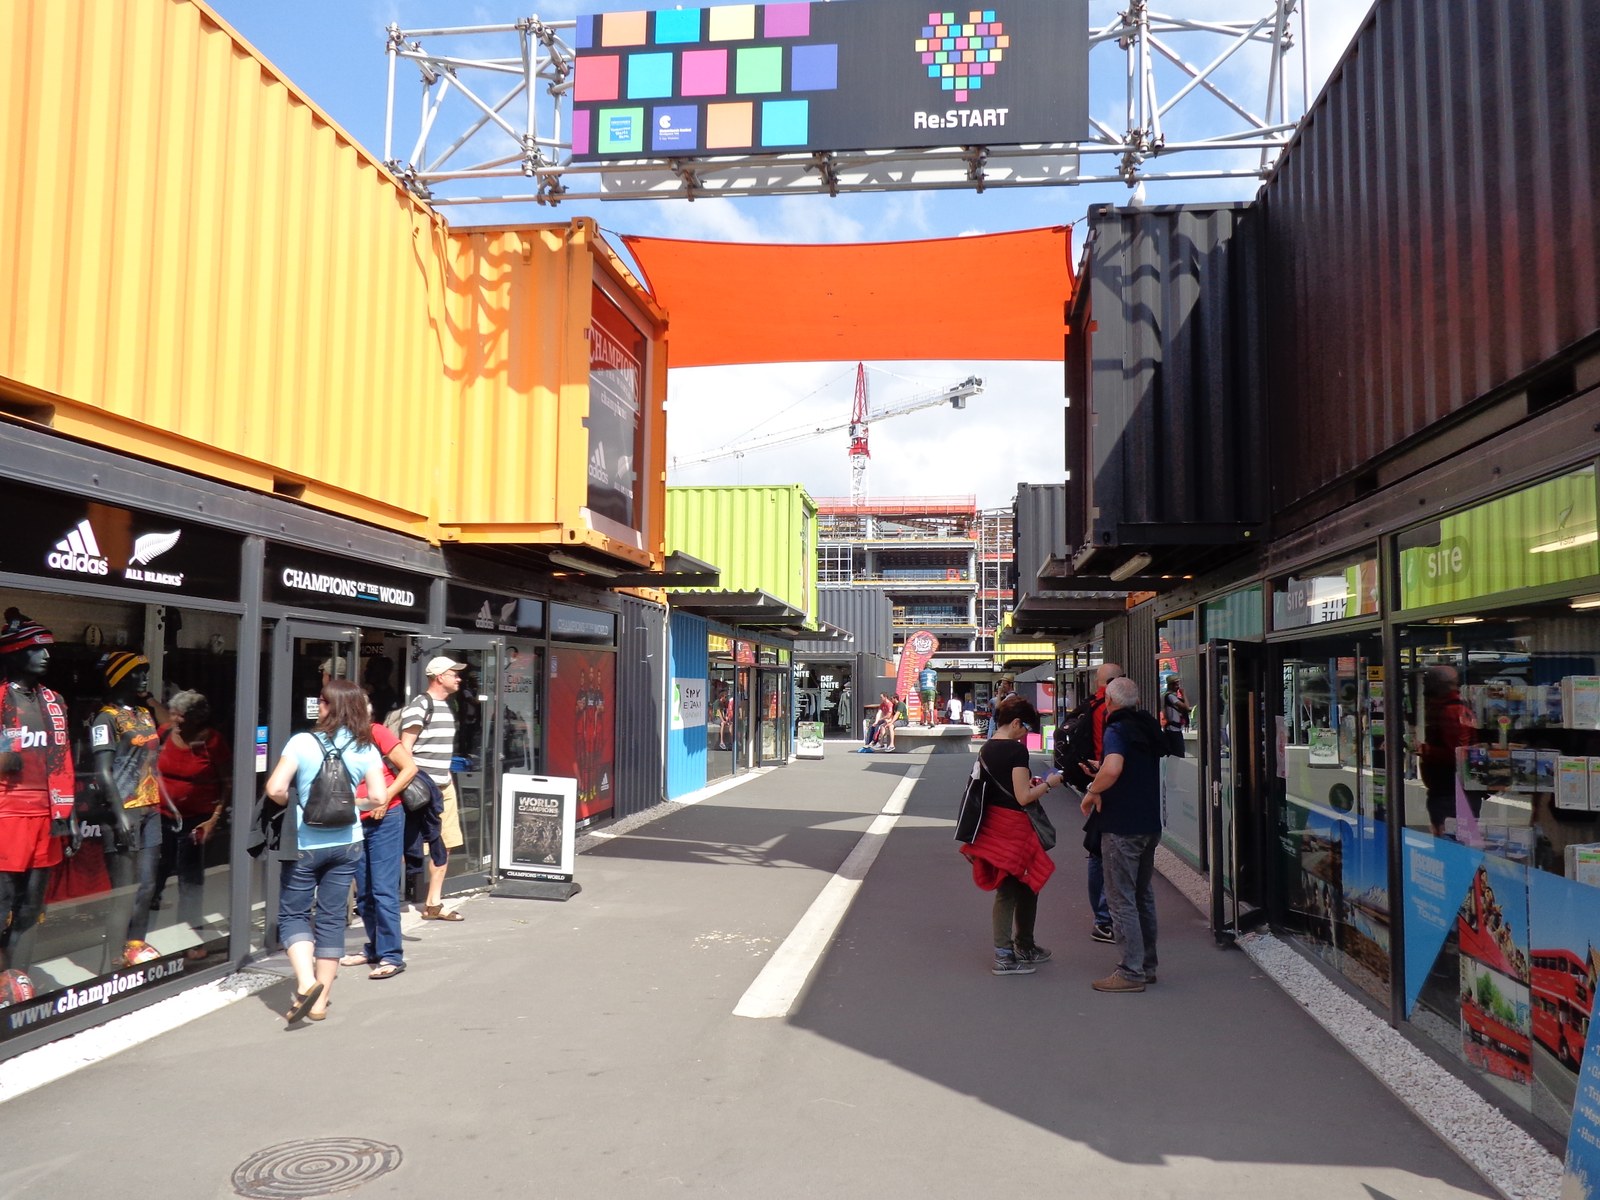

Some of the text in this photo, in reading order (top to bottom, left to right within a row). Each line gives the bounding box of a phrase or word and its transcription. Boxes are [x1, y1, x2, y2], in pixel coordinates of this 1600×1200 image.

[913, 108, 1009, 130] Re:START
[47, 551, 109, 576] adidas
[125, 568, 184, 587] ALL BLACKS
[282, 568, 415, 607] CHAMPIONS OF THE WORLD
[820, 681, 840, 689] INITE
[518, 805, 559, 814] CHAMPIONS
[519, 797, 559, 808] WORLD
[506, 871, 537, 879] CHAMPIONS
[10, 957, 185, 1030] www.champions.co.nz
